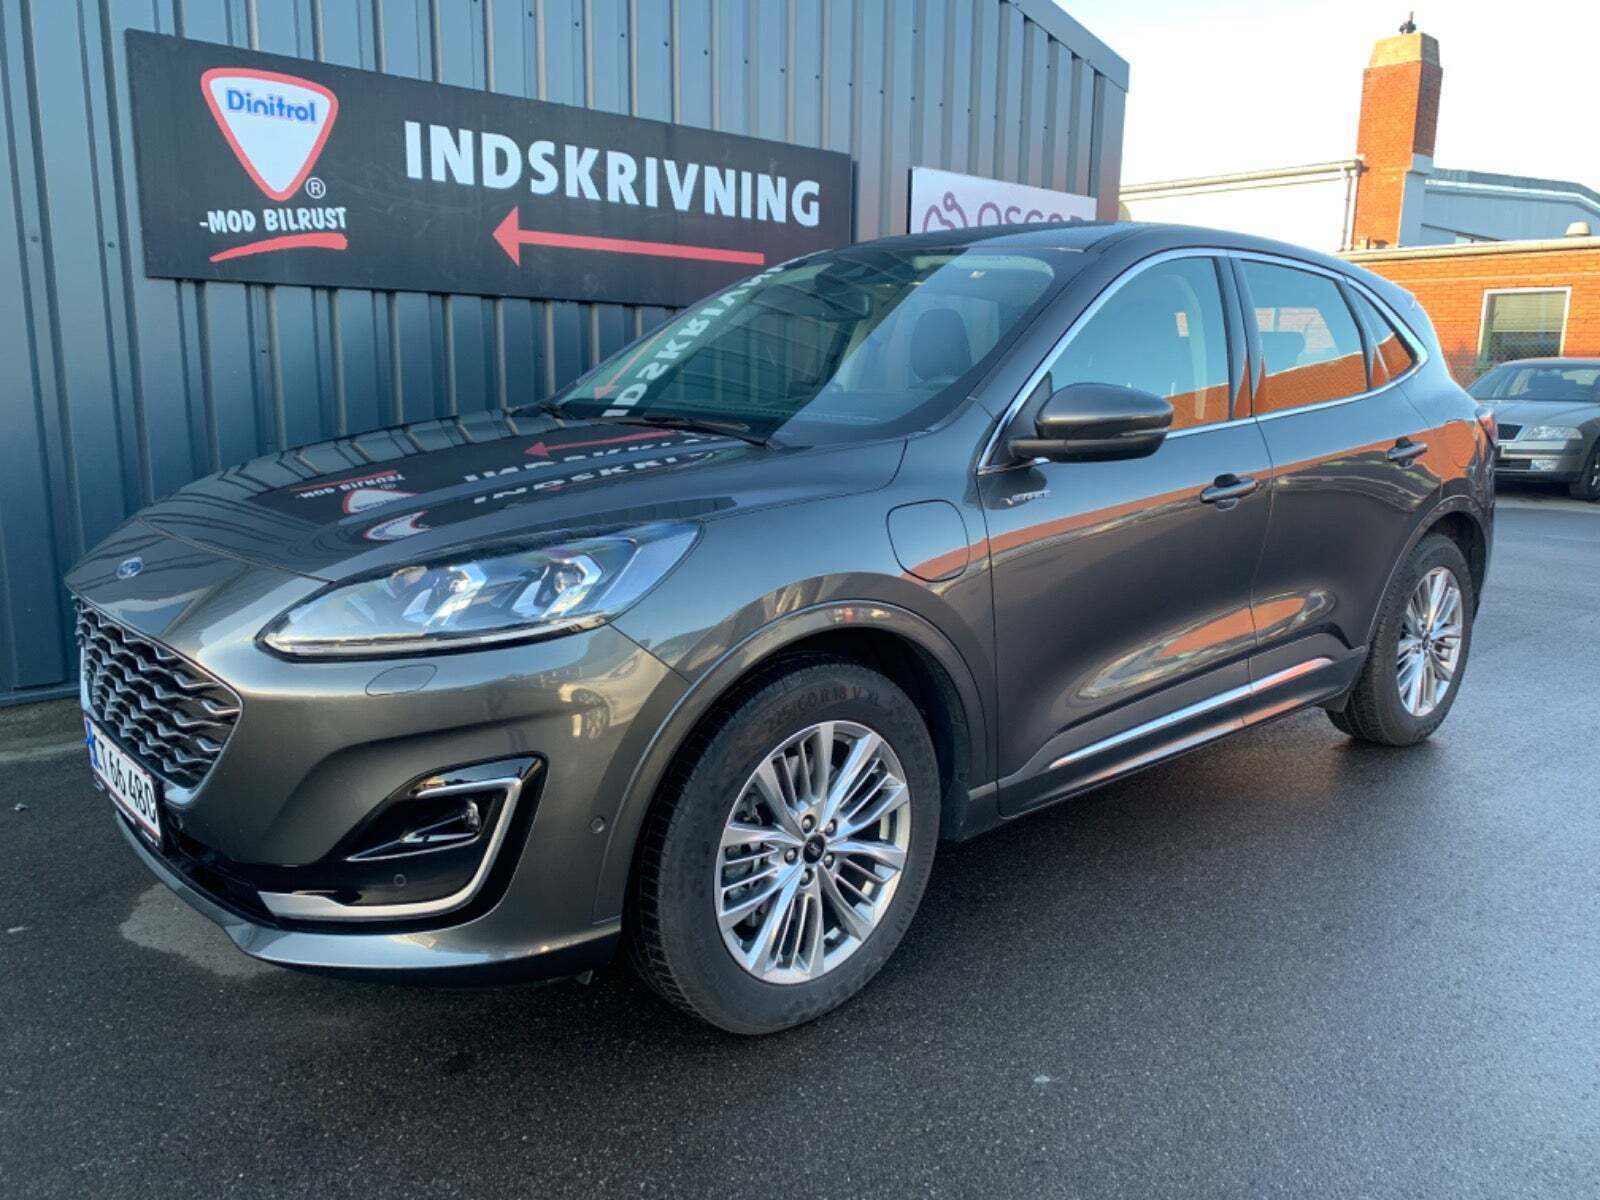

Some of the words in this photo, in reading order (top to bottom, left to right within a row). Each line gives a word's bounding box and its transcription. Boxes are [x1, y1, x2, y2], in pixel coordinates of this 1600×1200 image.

[226, 89, 316, 122] Dinitrol
[404, 120, 820, 227] INDSKRIVNING
[200, 210, 256, 233] -MOD
[264, 207, 347, 231] BILRUST
[977, 201, 1083, 226] OSC
